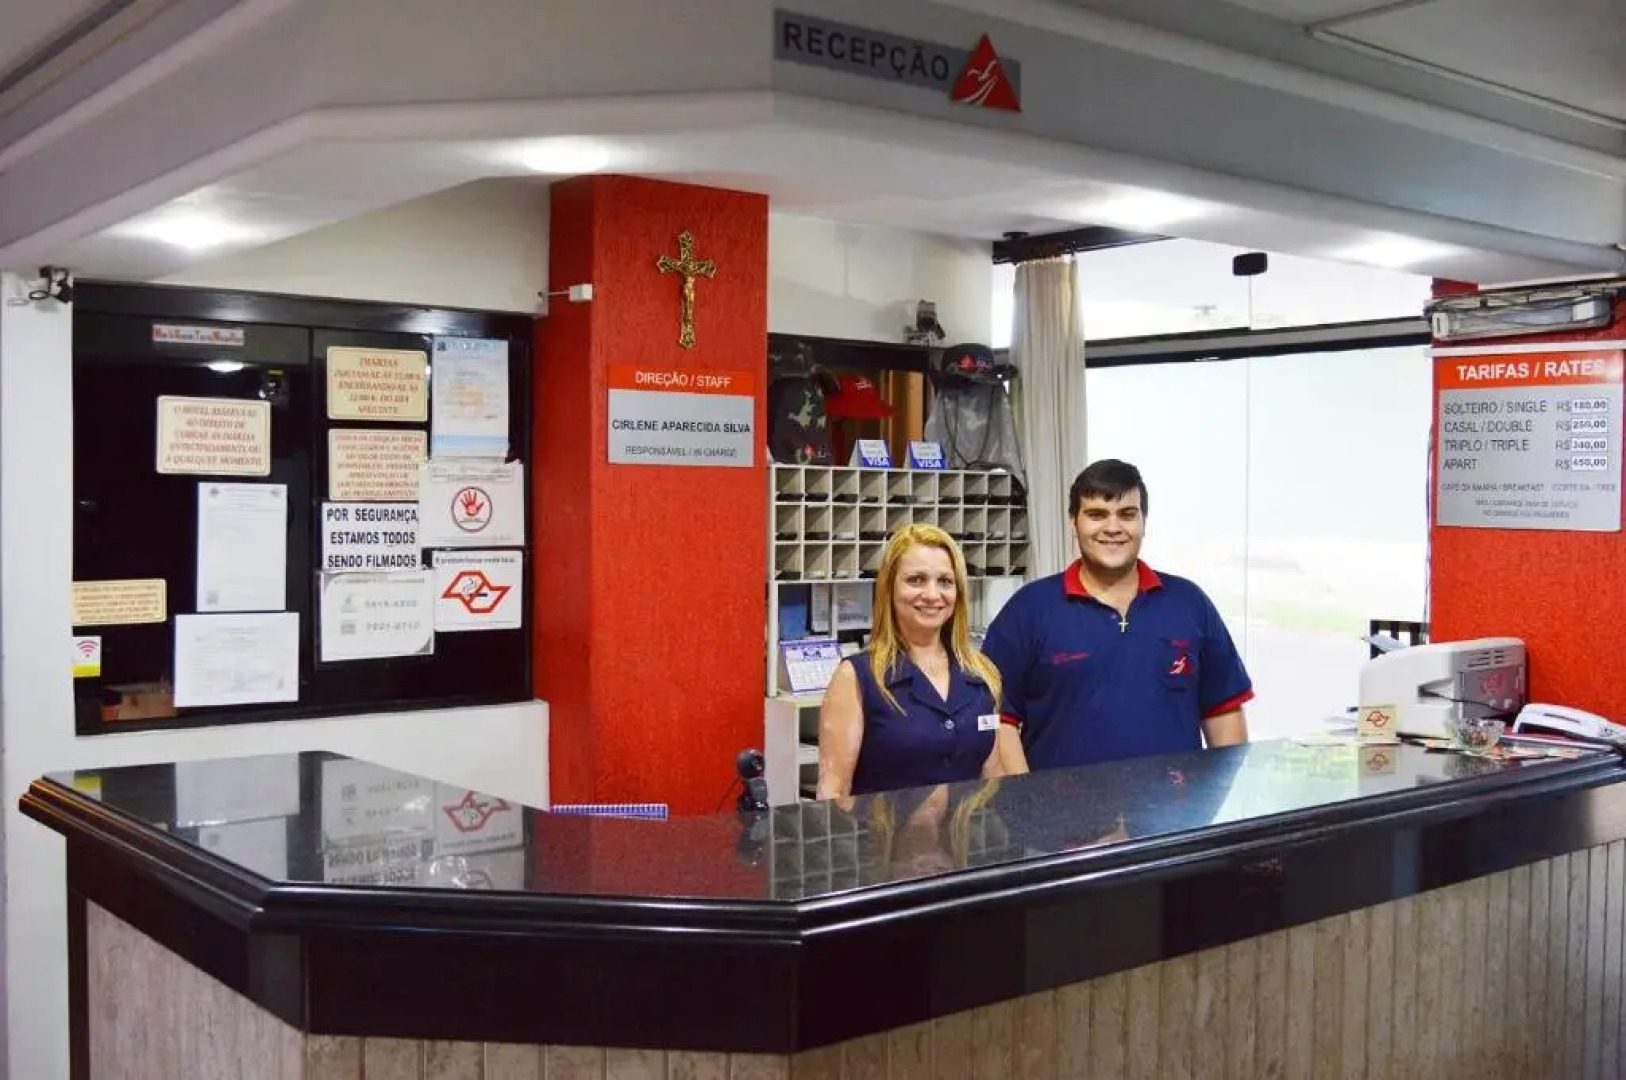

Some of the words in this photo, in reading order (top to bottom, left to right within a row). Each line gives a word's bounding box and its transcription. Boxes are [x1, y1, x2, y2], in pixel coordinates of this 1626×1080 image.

[783, 21, 949, 81] RECEPÇÃO
[1457, 363, 1530, 381] TARIFAS
[1533, 362, 1541, 378] /
[1544, 358, 1606, 377] RATES
[635, 371, 688, 388] DIREÇÃO
[689, 376, 695, 387] /
[696, 376, 732, 388] STAFF
[1444, 401, 1498, 415] SOLTEIRO
[1506, 399, 1548, 413] SINGLE
[612, 418, 659, 431] CIRLENE
[661, 420, 721, 433] APARECIDA
[723, 422, 751, 434] SILVA
[1444, 420, 1479, 433] CASAL
[1487, 419, 1533, 433] DOUBLE
[1444, 440, 1483, 452] TRIPLO
[1490, 439, 1530, 451] TRIPLE
[867, 457, 889, 467] VISA
[917, 459, 942, 468] VISA
[1443, 458, 1477, 470] APART
[326, 507, 349, 521] POR
[330, 531, 380, 545] ESTAMOS
[383, 531, 416, 545] TODOS
[328, 555, 363, 568] SENDO
[366, 554, 417, 568] FILMADOS
